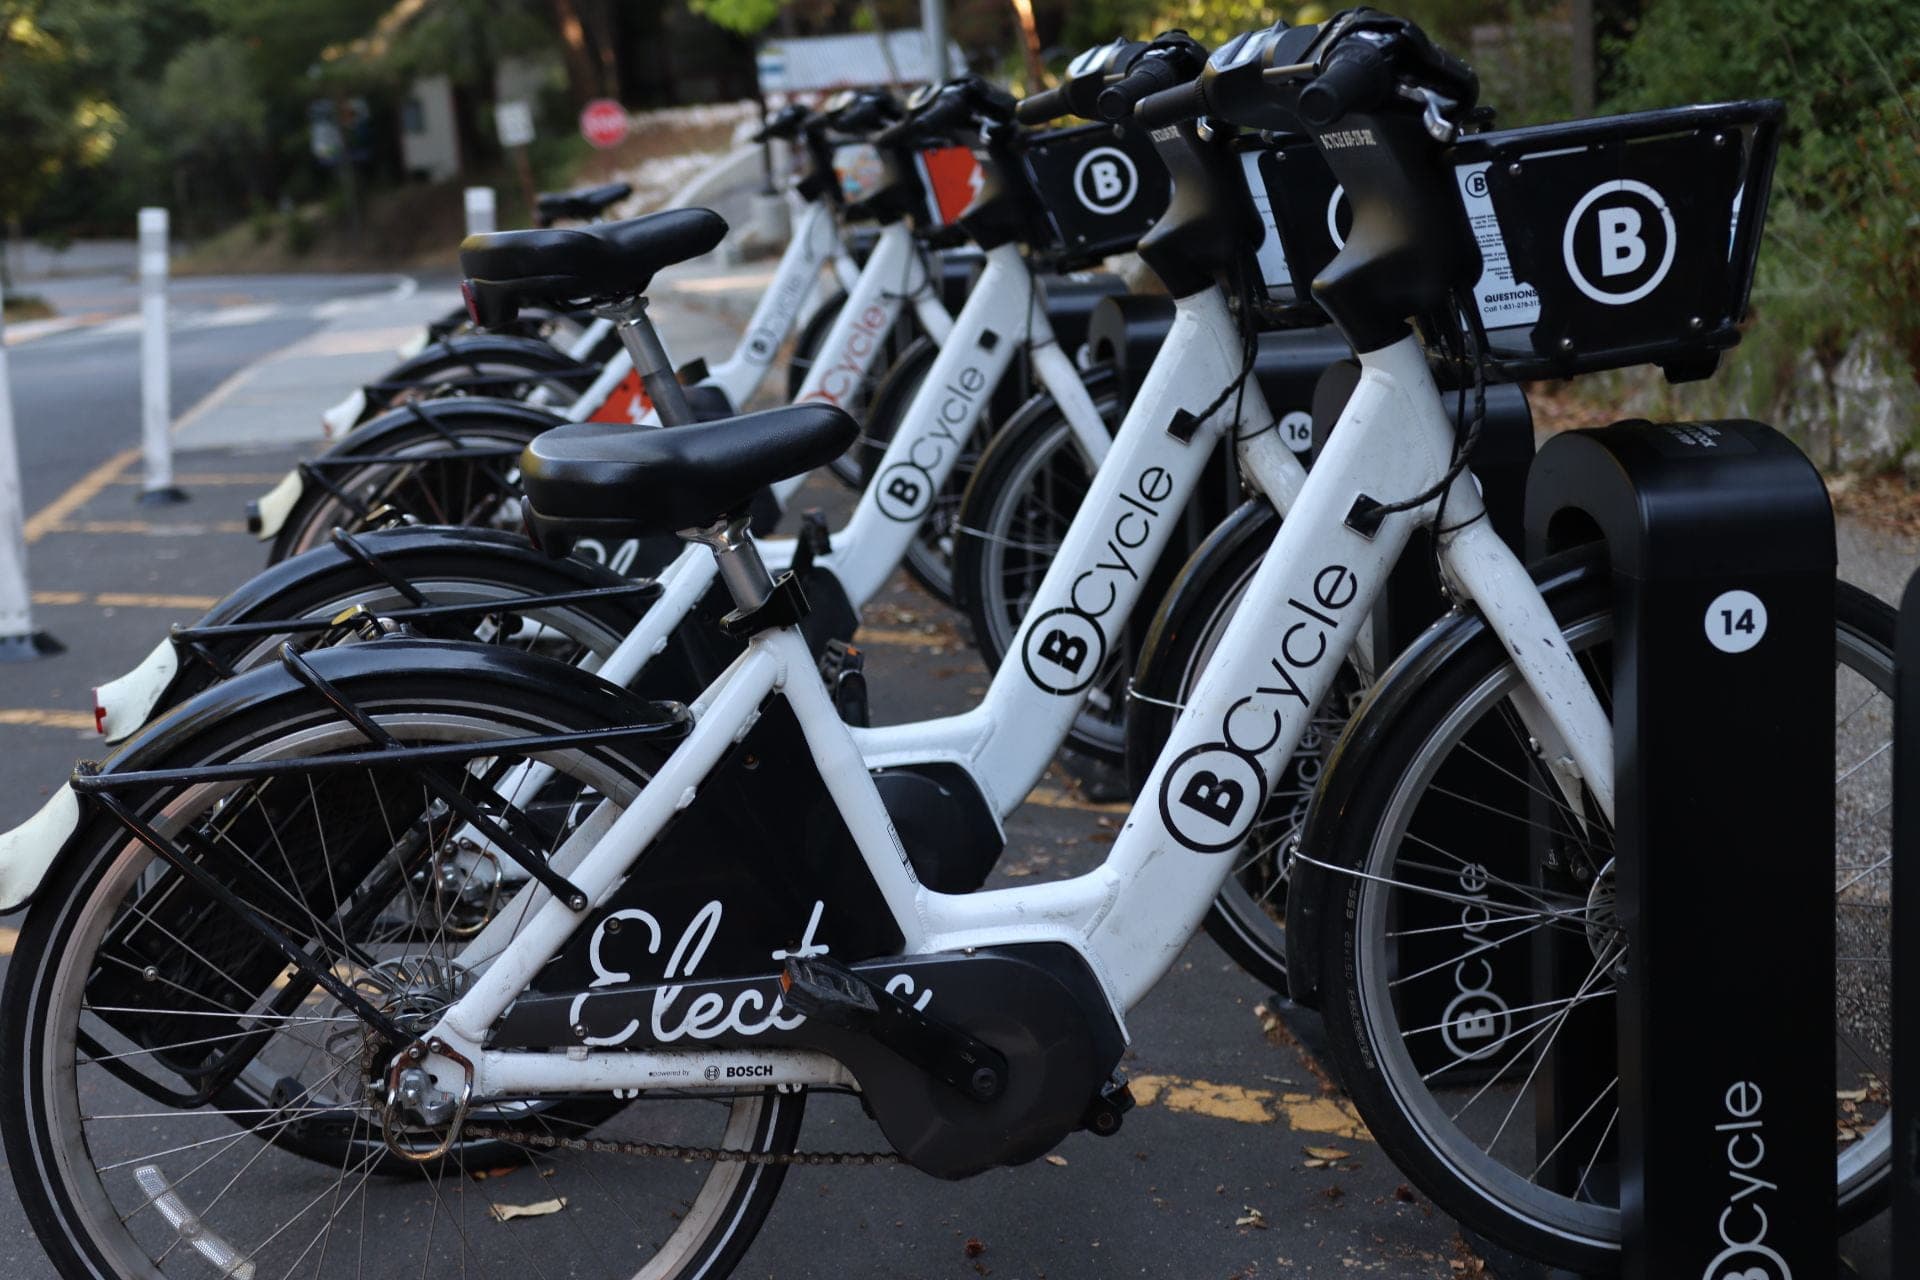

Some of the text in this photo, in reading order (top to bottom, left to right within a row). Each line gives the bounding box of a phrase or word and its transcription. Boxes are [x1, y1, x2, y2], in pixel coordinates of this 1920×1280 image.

[876, 367, 985, 522] BCycle
[1288, 424, 1309, 440] 16
[1022, 467, 1173, 696] BCycle
[1720, 608, 1755, 635] 14
[1159, 565, 1358, 854] BCycle
[1441, 863, 1512, 1060] BCycle
[726, 1065, 773, 1077] BOSCH
